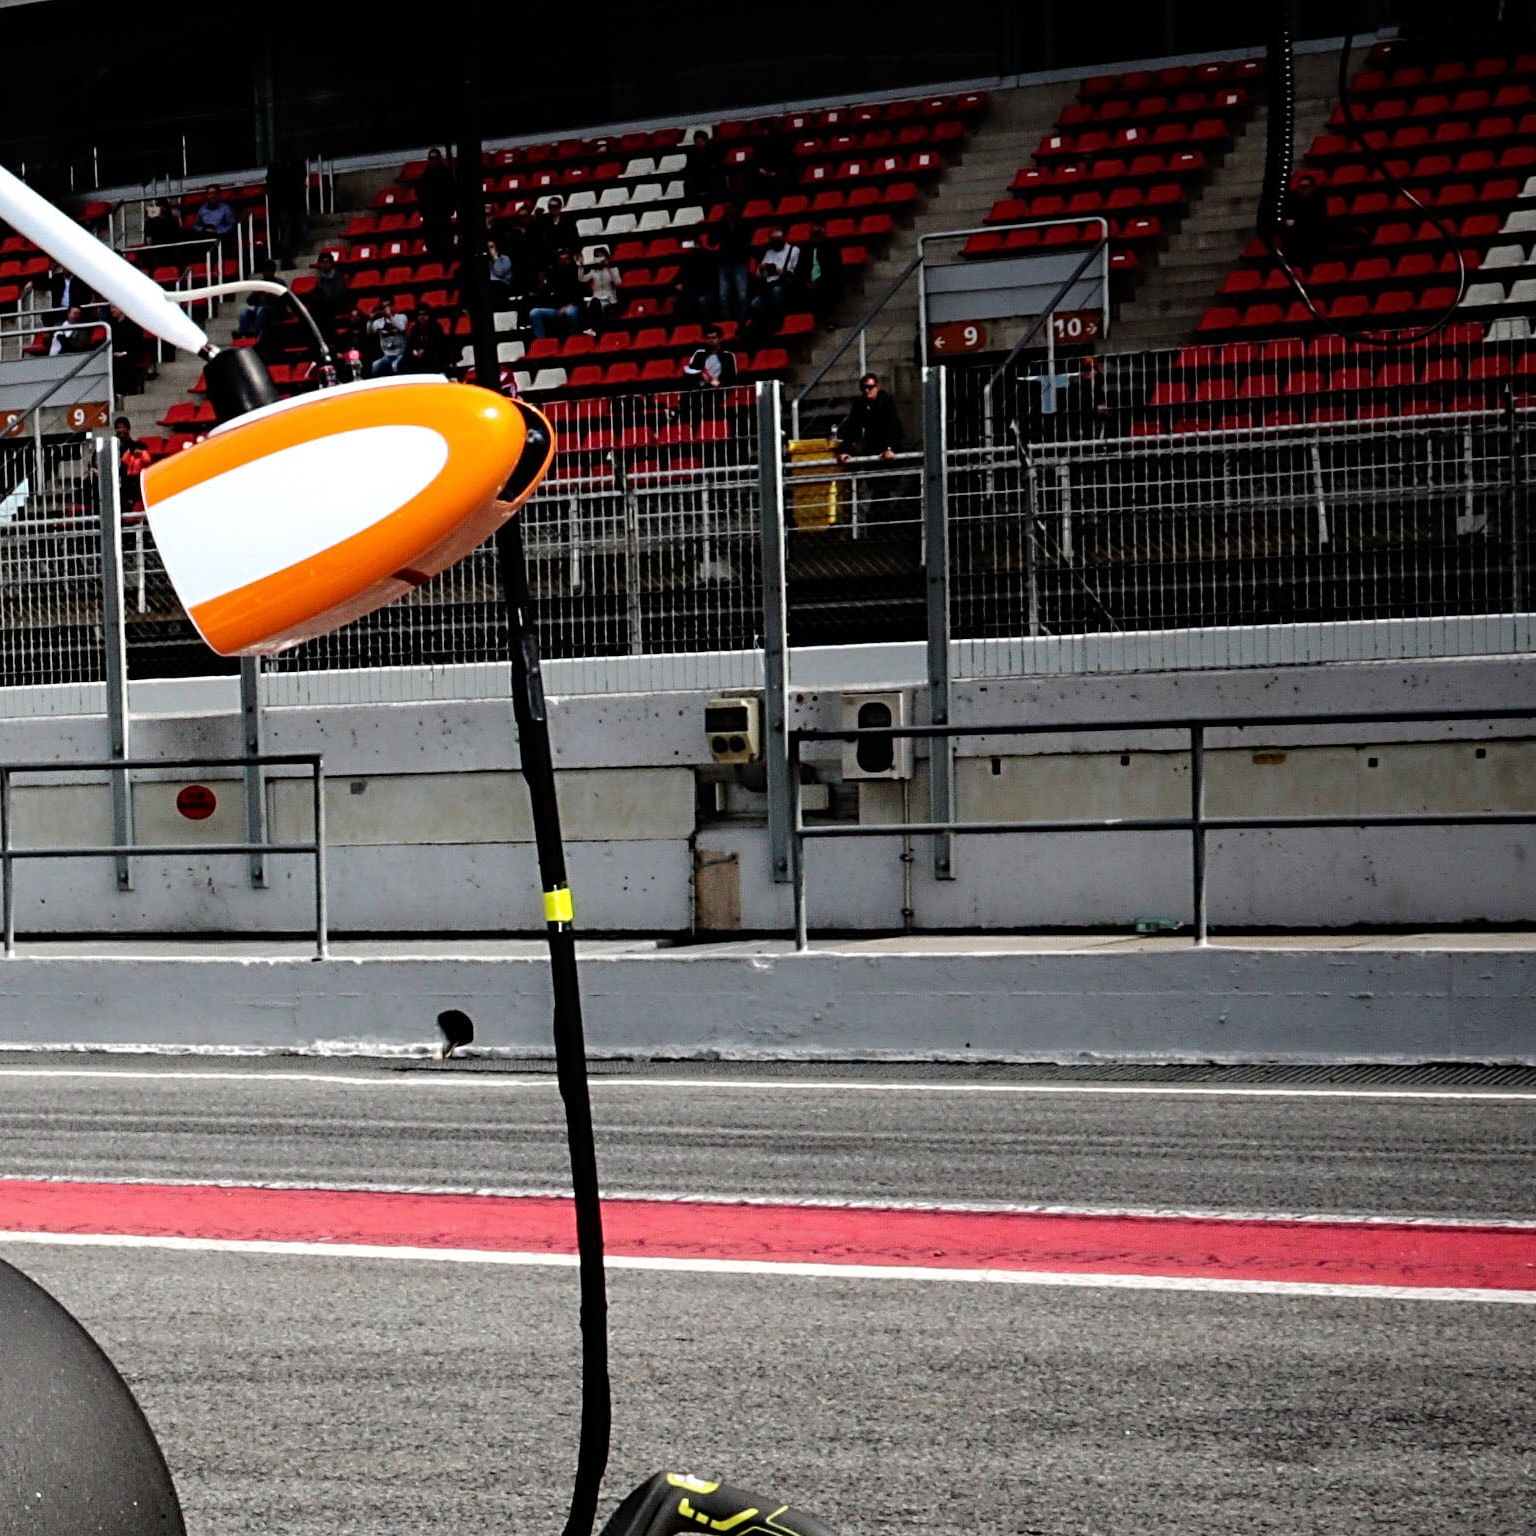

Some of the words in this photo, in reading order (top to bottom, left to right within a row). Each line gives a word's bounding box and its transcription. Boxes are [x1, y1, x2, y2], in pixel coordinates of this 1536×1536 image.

[963, 325, 979, 346] 9
[1054, 317, 1083, 339] 10
[73, 408, 86, 426] 9
